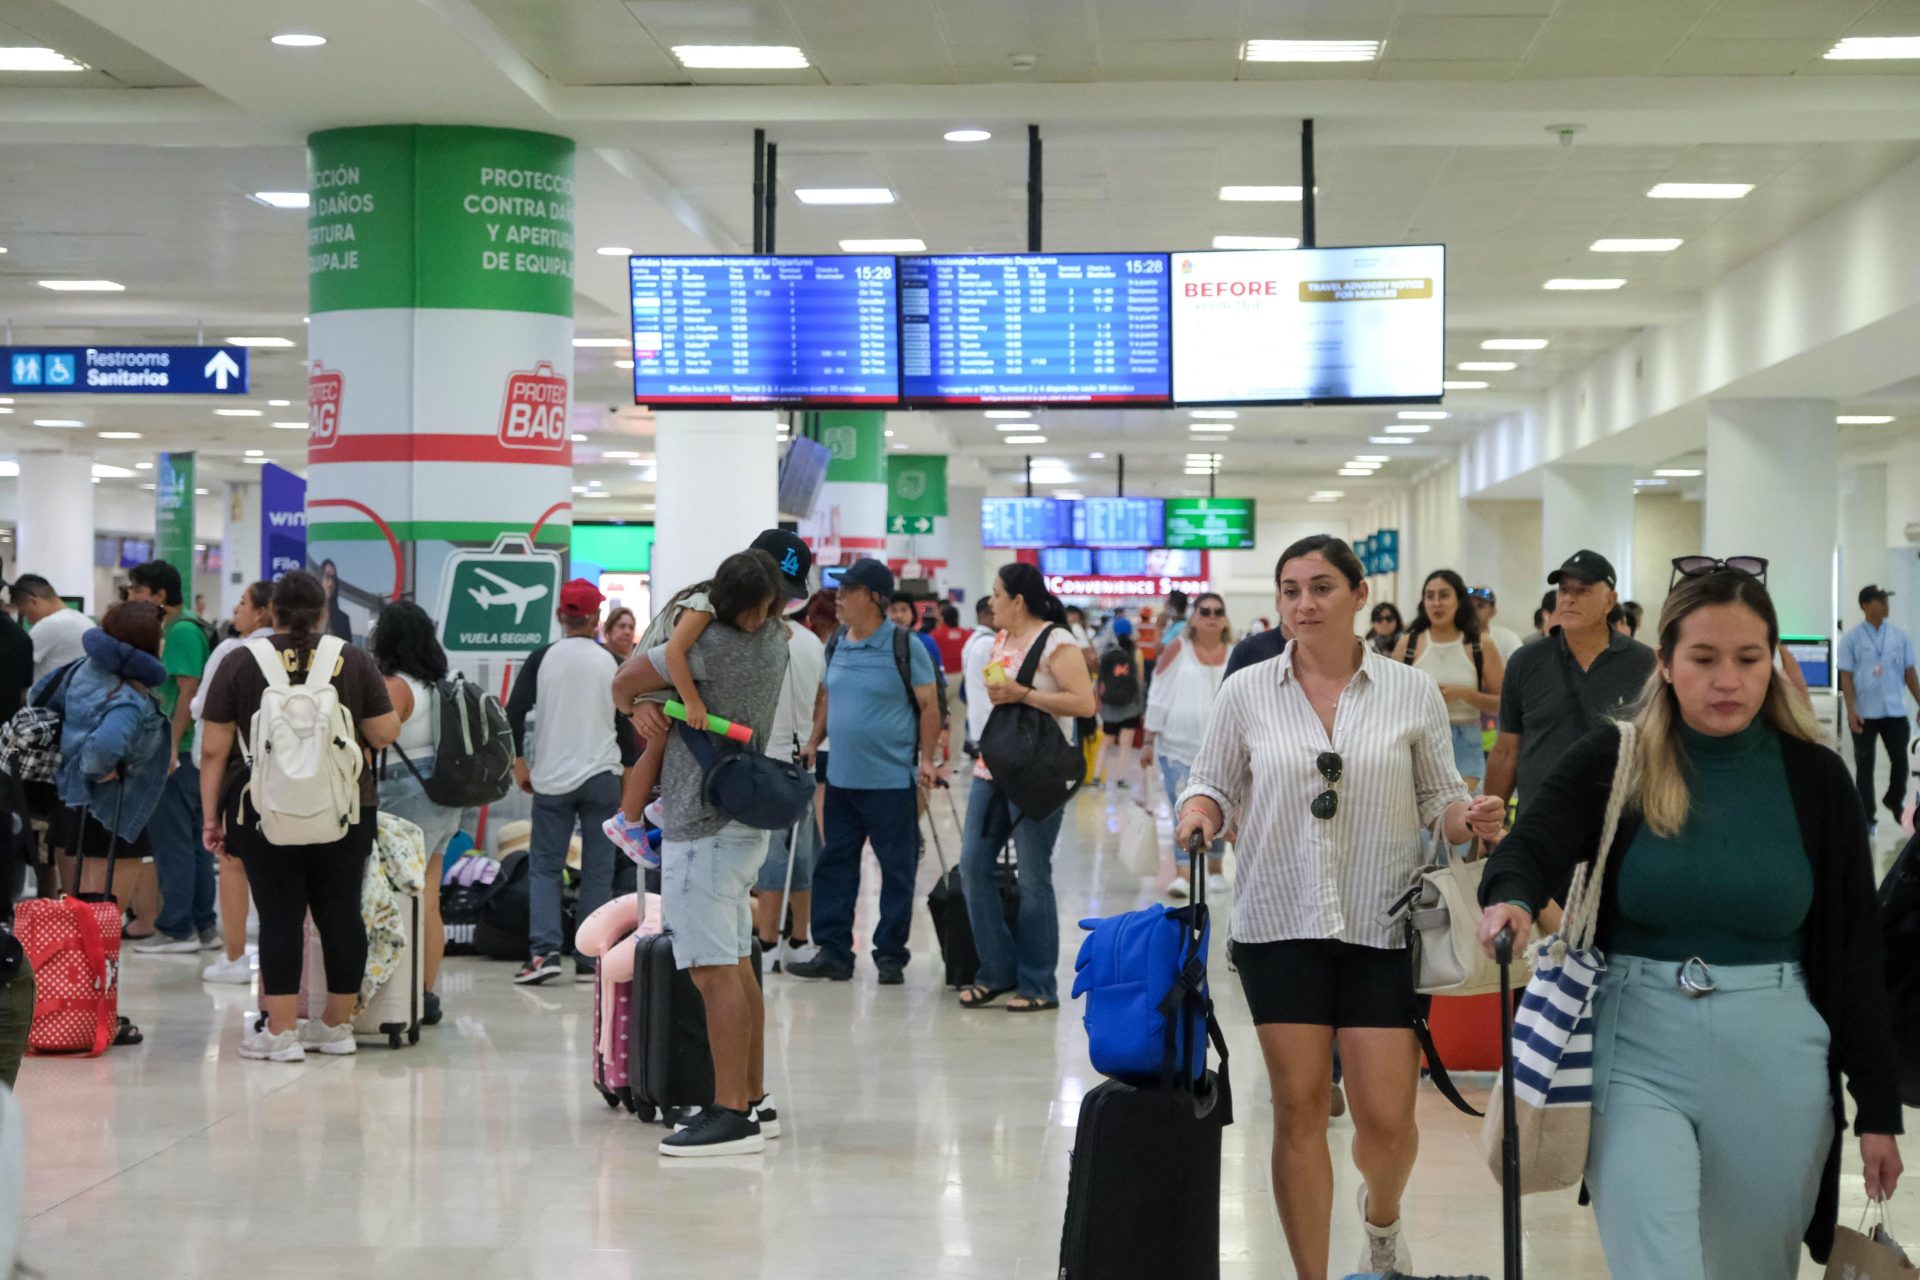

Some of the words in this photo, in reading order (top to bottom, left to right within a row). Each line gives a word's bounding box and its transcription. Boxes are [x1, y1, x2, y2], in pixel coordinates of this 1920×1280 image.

[319, 191, 374, 216] DAÑOS
[464, 194, 546, 217] CONTRA
[487, 223, 500, 242] Y
[483, 251, 510, 271] DE
[772, 258, 813, 267] Departures
[1126, 259, 1163, 273] 15:28
[854, 266, 893, 280] 15:28
[1185, 281, 1277, 298] BEFORE
[1307, 282, 1343, 292] TRAVEL
[1344, 281, 1390, 291] ADVISORY
[86, 348, 170, 367] Restrooms
[87, 368, 169, 386] Sanitarios
[512, 382, 566, 405] PROTEC
[506, 403, 564, 440] BAG
[780, 547, 799, 576] LA
[460, 633, 498, 645] VUELA
[500, 633, 542, 645] SEGURO
